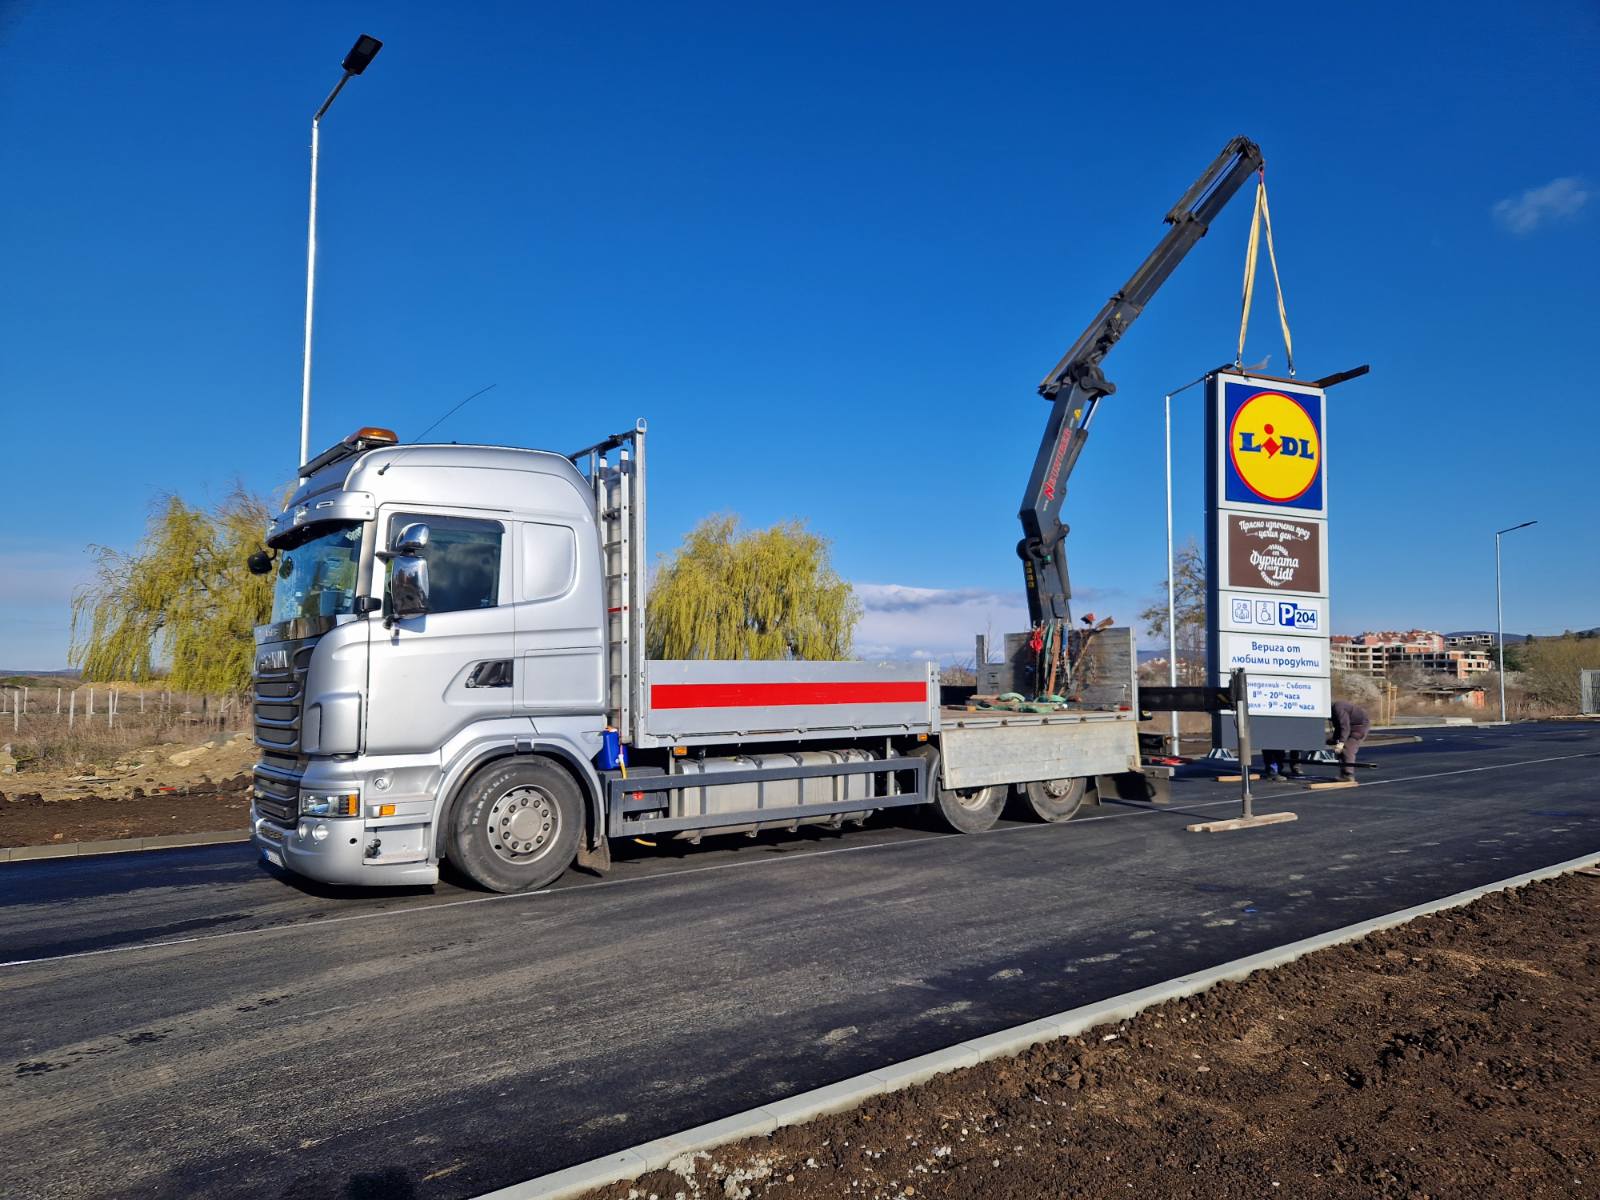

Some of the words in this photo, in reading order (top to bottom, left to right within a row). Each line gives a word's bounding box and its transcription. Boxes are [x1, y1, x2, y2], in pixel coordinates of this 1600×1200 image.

[1250, 549, 1299, 570] Фурната
[1272, 566, 1294, 581] Lidl
[1280, 603, 1294, 625] P
[1296, 611, 1316, 624] 204
[1251, 641, 1285, 653] Верига
[1287, 645, 1301, 653] от
[1231, 654, 1270, 665] любими
[1272, 657, 1320, 668] продукти
